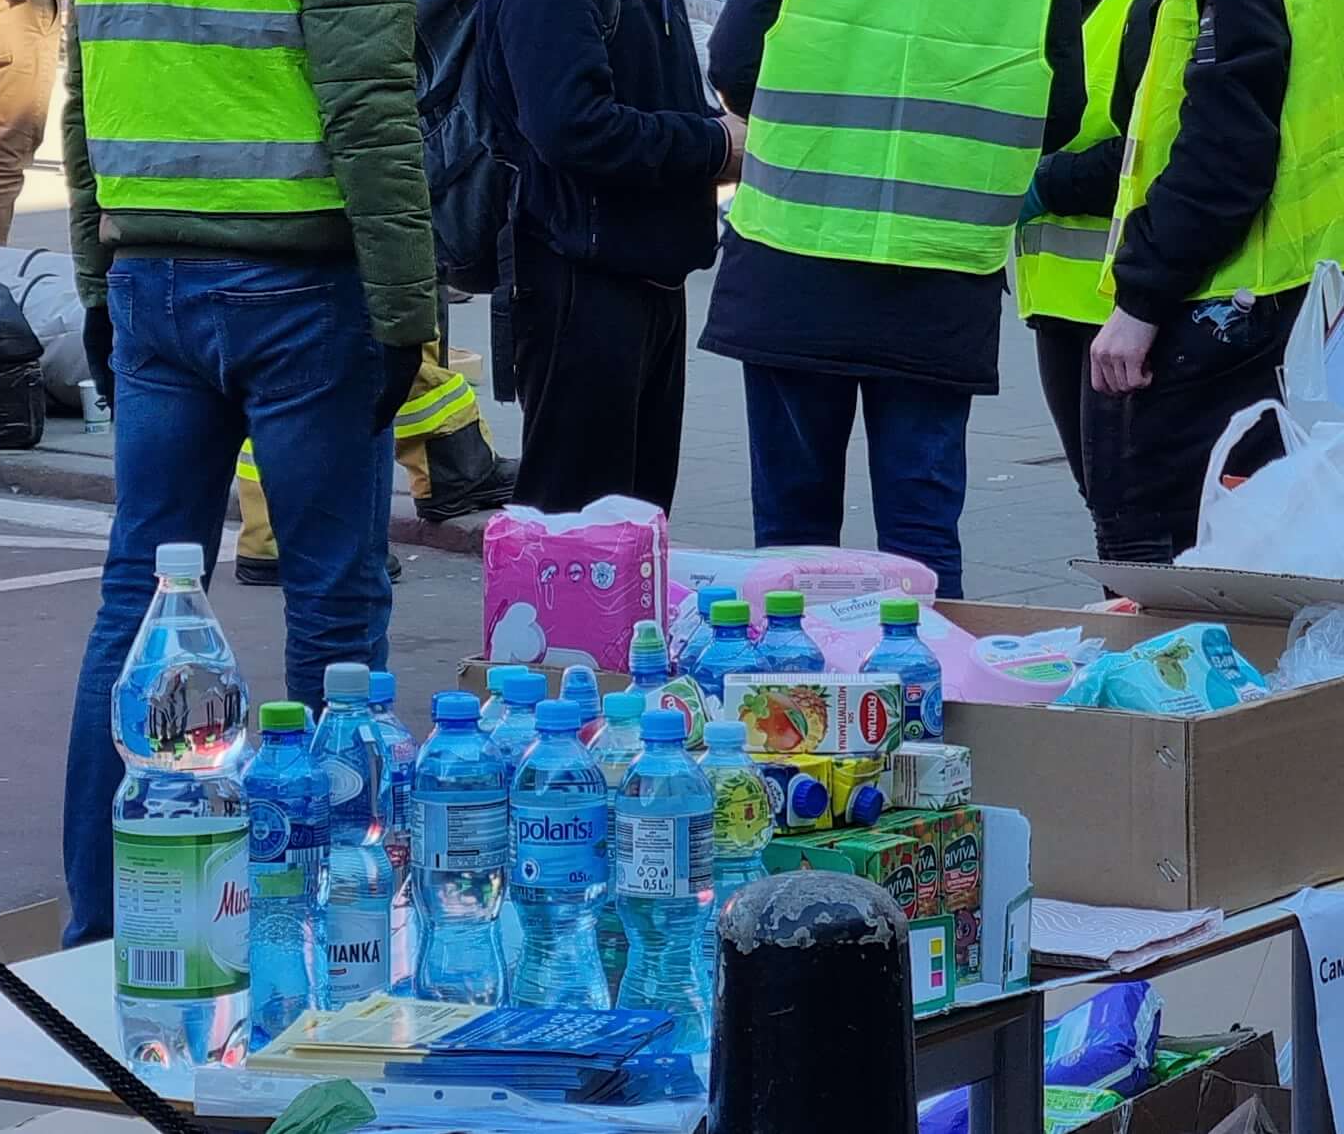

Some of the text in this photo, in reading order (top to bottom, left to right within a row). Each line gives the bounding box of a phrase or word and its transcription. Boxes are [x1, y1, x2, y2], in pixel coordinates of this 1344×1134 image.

[838, 686, 847, 751] MULTIWITAMINA
[867, 695, 877, 742] FORTUNA
[520, 815, 587, 843] polaris
[944, 846, 976, 867] RIVIVA
